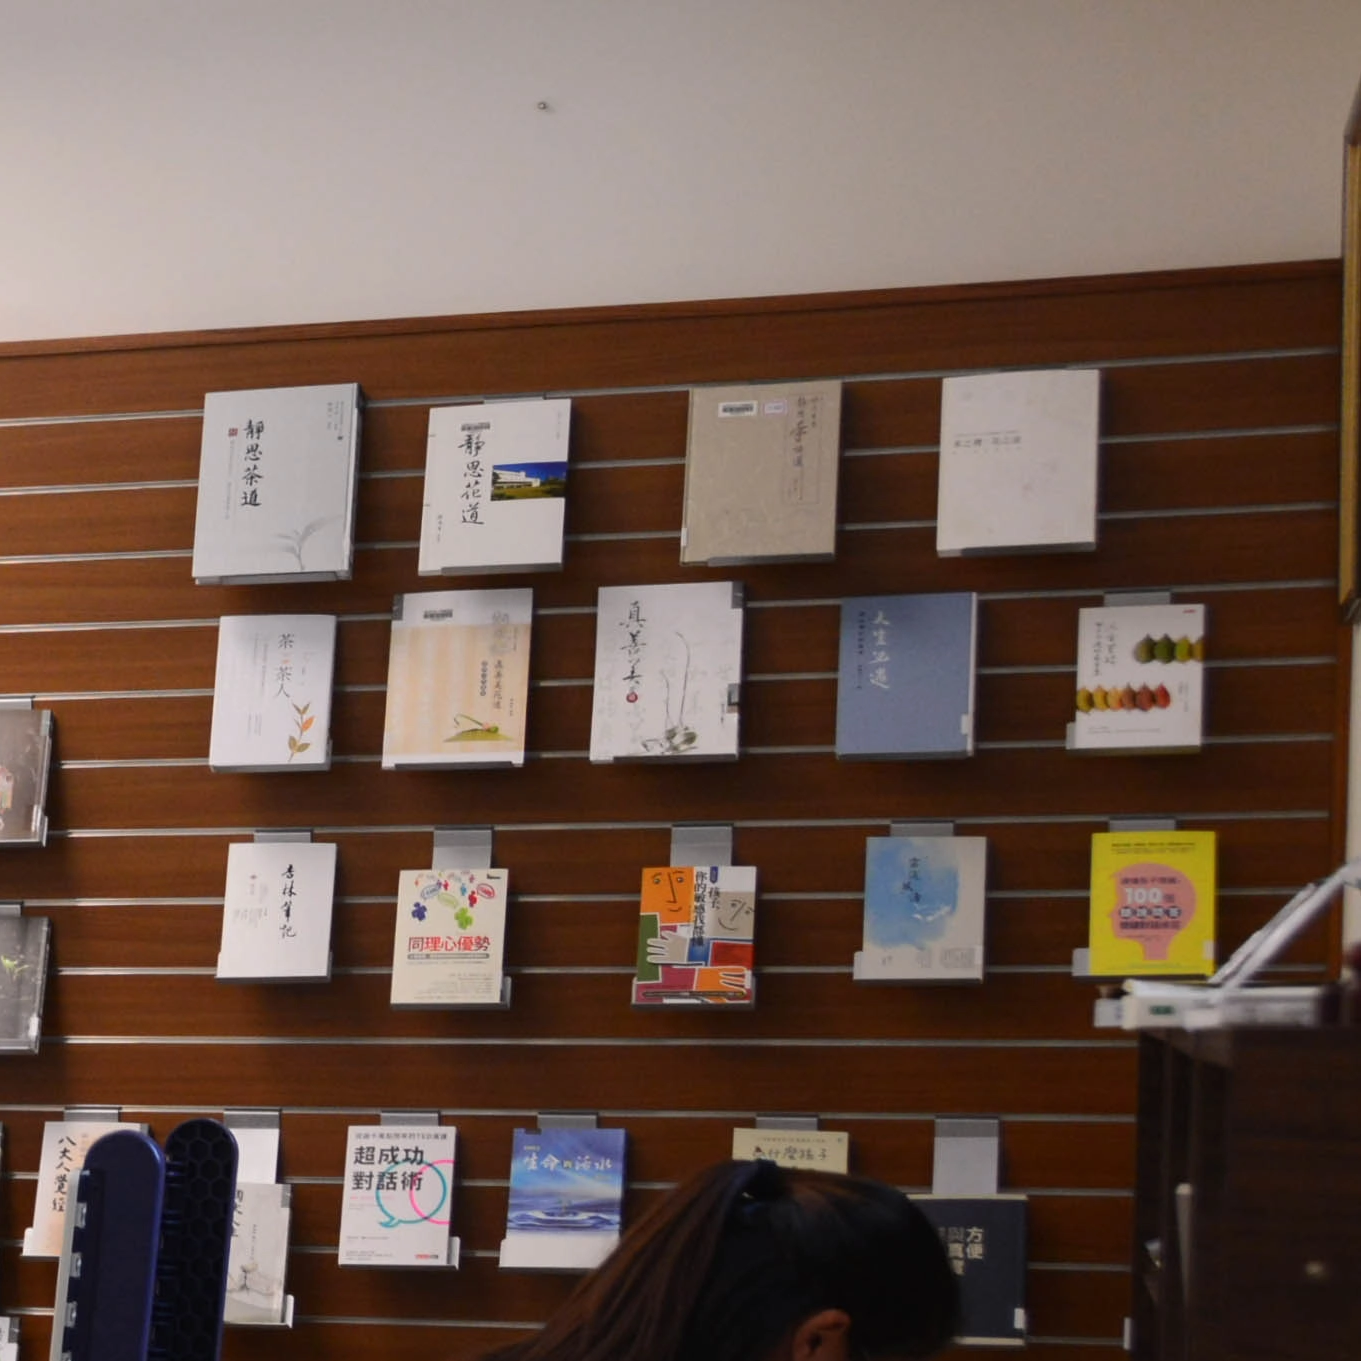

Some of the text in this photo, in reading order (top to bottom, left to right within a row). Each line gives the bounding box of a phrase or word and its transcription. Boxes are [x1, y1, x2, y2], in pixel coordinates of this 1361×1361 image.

[240, 418, 265, 507] 靜思茶道
[458, 433, 485, 525] 靜思花道
[407, 935, 491, 952] 同理心優勢
[353, 1146, 425, 1165] 超成功
[52, 1136, 77, 1213] 八大人覺經
[351, 1171, 423, 1191] 對話術
[966, 1226, 984, 1259] 方便
